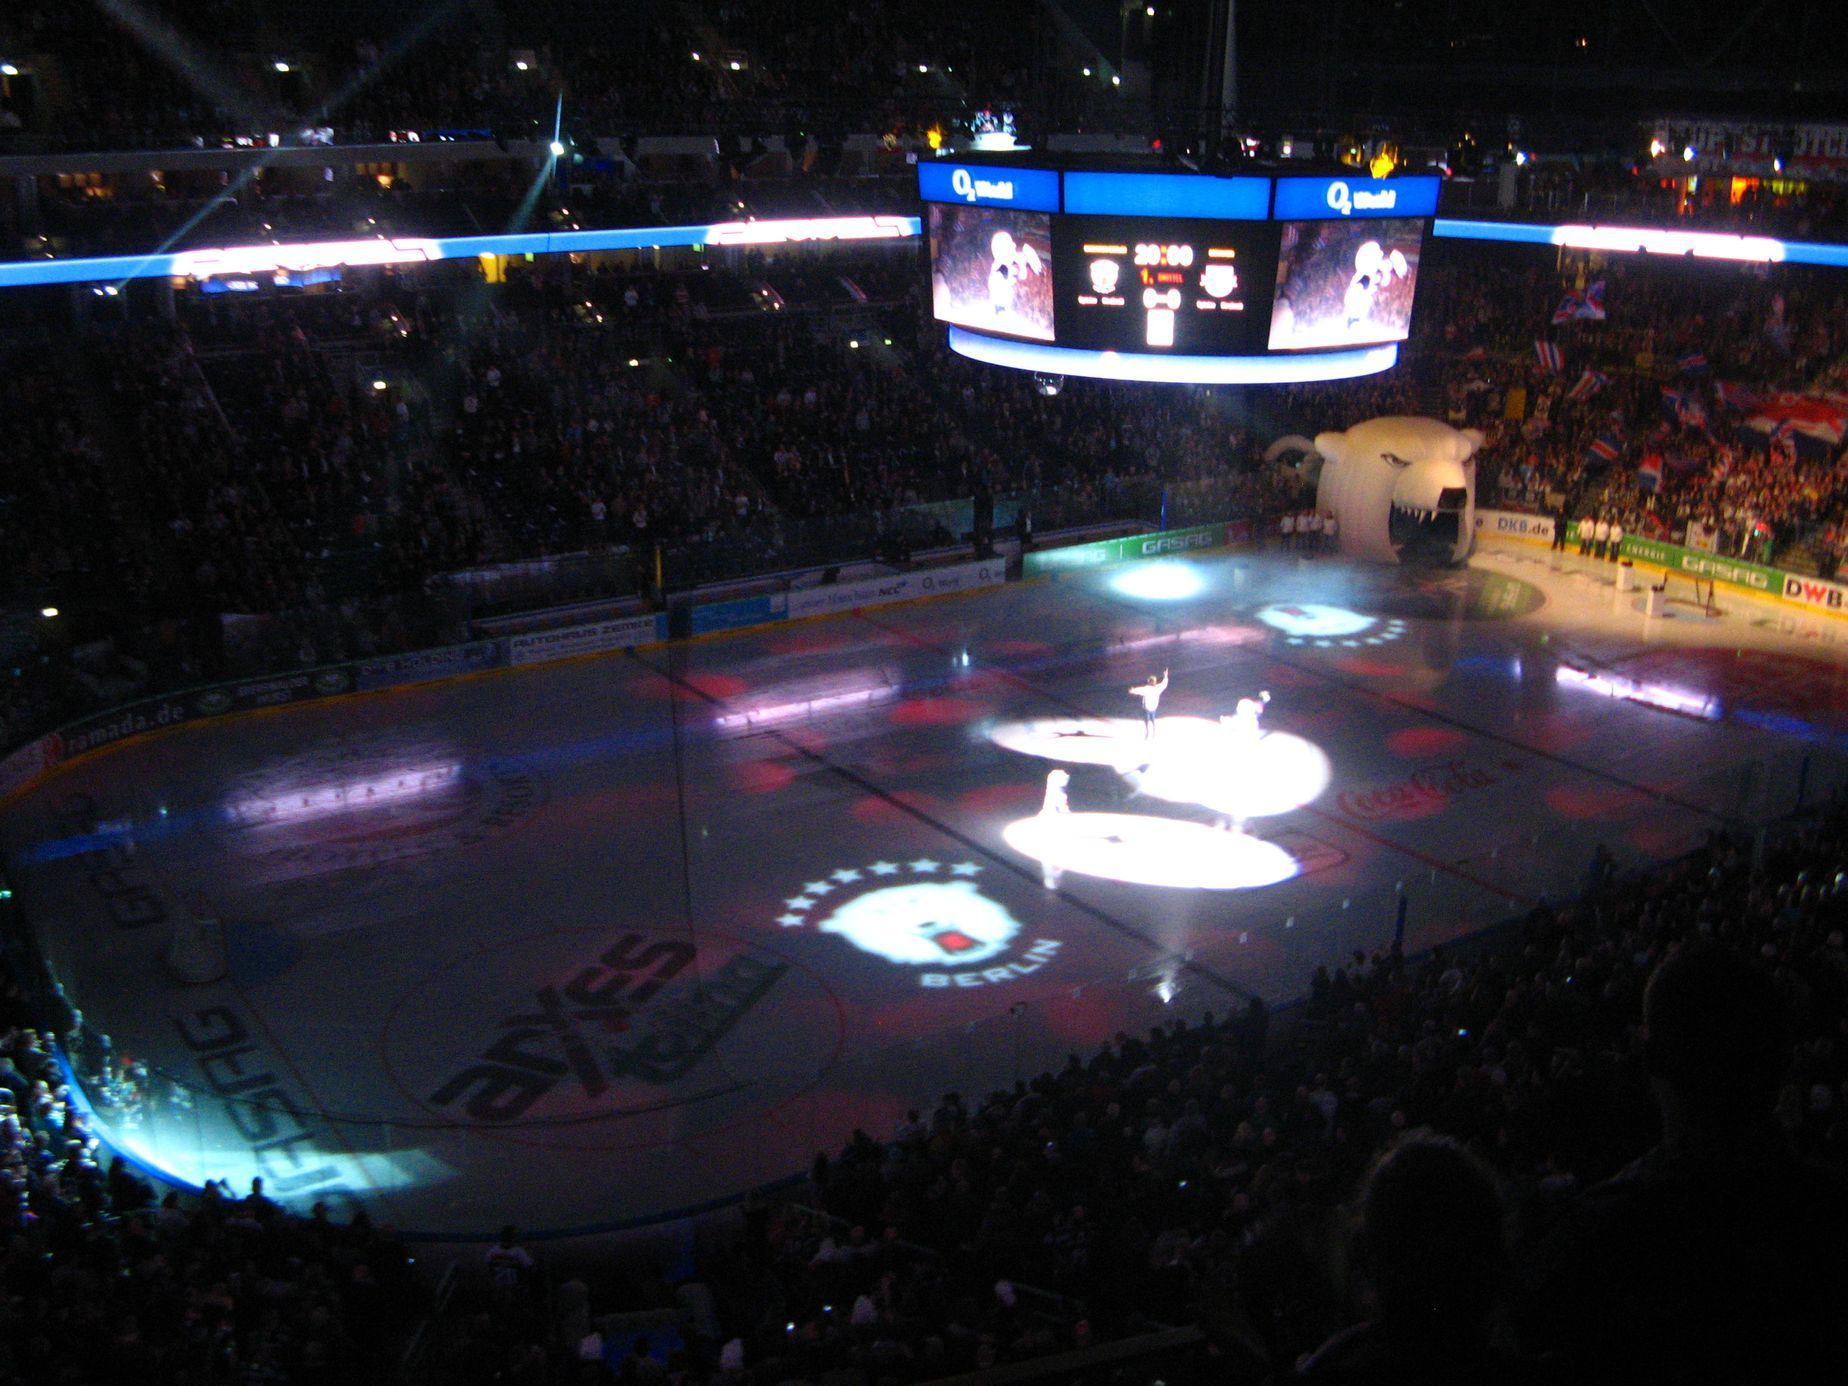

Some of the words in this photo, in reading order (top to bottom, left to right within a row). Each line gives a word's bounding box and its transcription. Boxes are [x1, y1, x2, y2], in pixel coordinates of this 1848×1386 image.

[1498, 516, 1549, 535] DKB.de
[1142, 532, 1212, 555] GASAG
[1681, 556, 1768, 590] GASAG
[1785, 576, 1843, 609] DWB
[68, 703, 185, 752] ramada.de
[920, 938, 1063, 988] BERLIN
